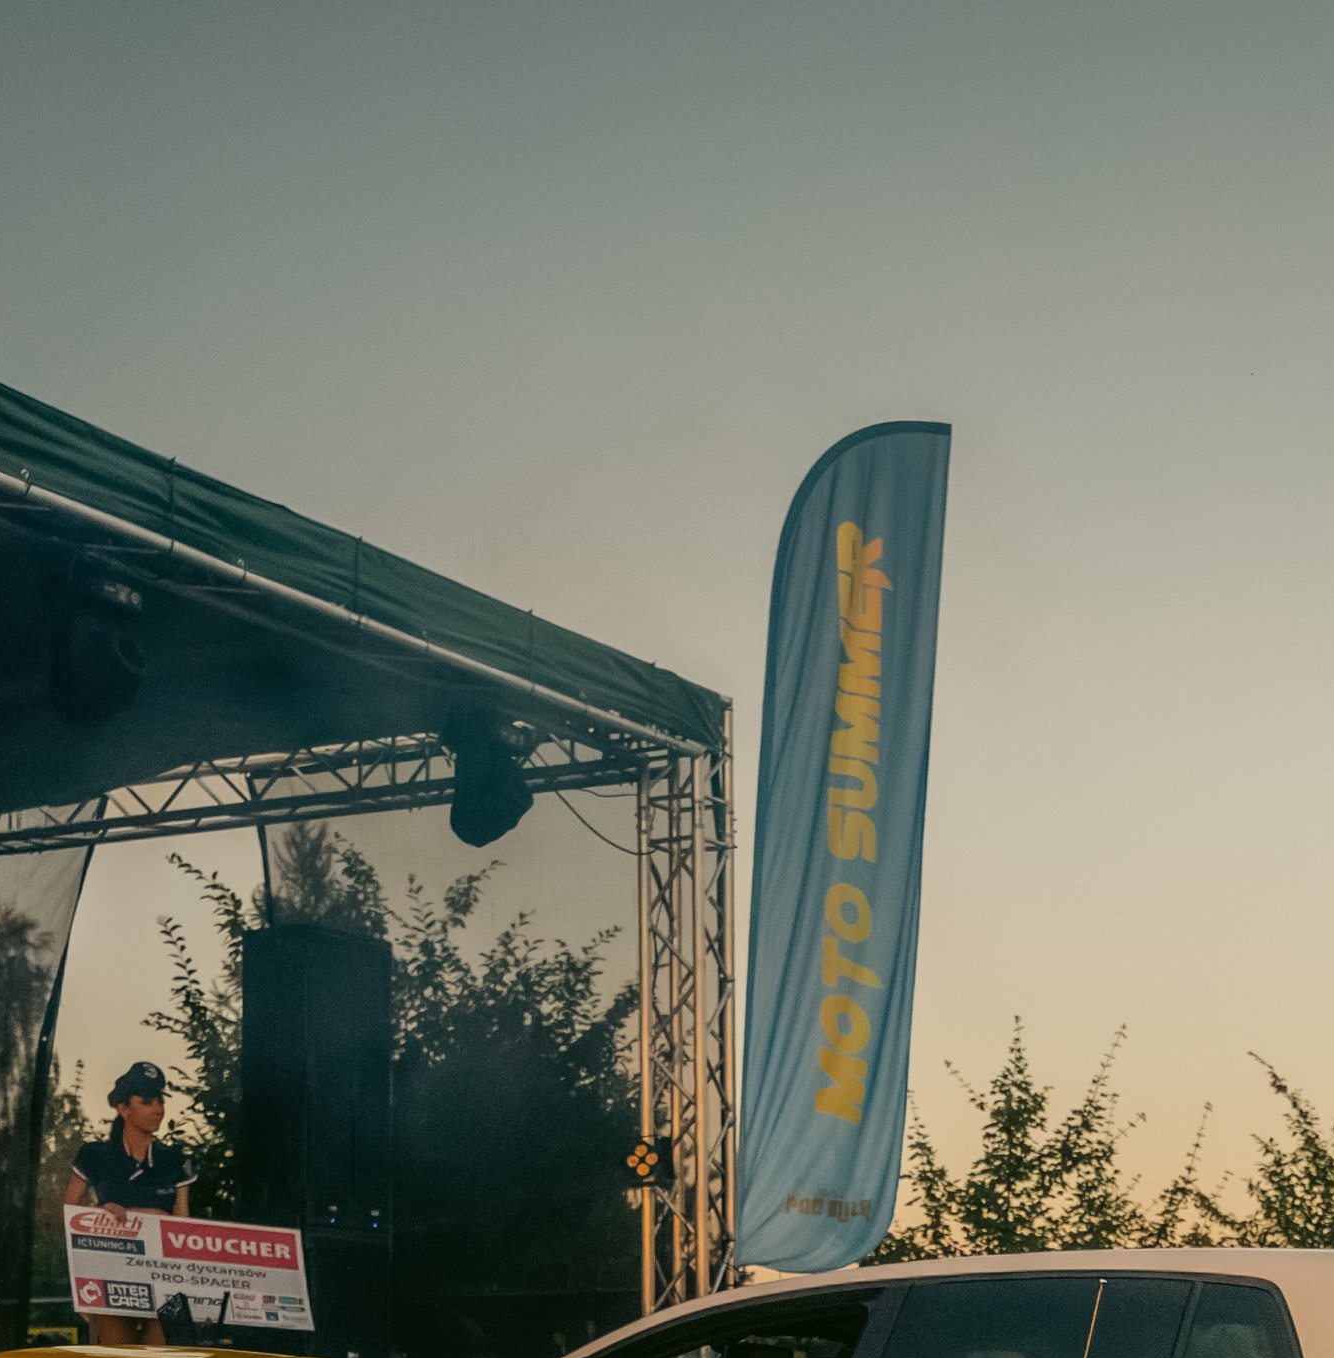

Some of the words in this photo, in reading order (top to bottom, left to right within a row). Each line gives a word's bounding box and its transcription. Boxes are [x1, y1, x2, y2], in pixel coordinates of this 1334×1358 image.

[827, 521, 893, 863] SUMMER
[815, 883, 884, 1124] MOTO
[167, 1232, 291, 1260] VOUCHER
[125, 1257, 182, 1271] Zestaw
[186, 1263, 267, 1279] dystansów
[107, 1283, 149, 1297] INTER
[151, 1272, 251, 1290] PRO-SPACER
[109, 1295, 151, 1308] CARS
